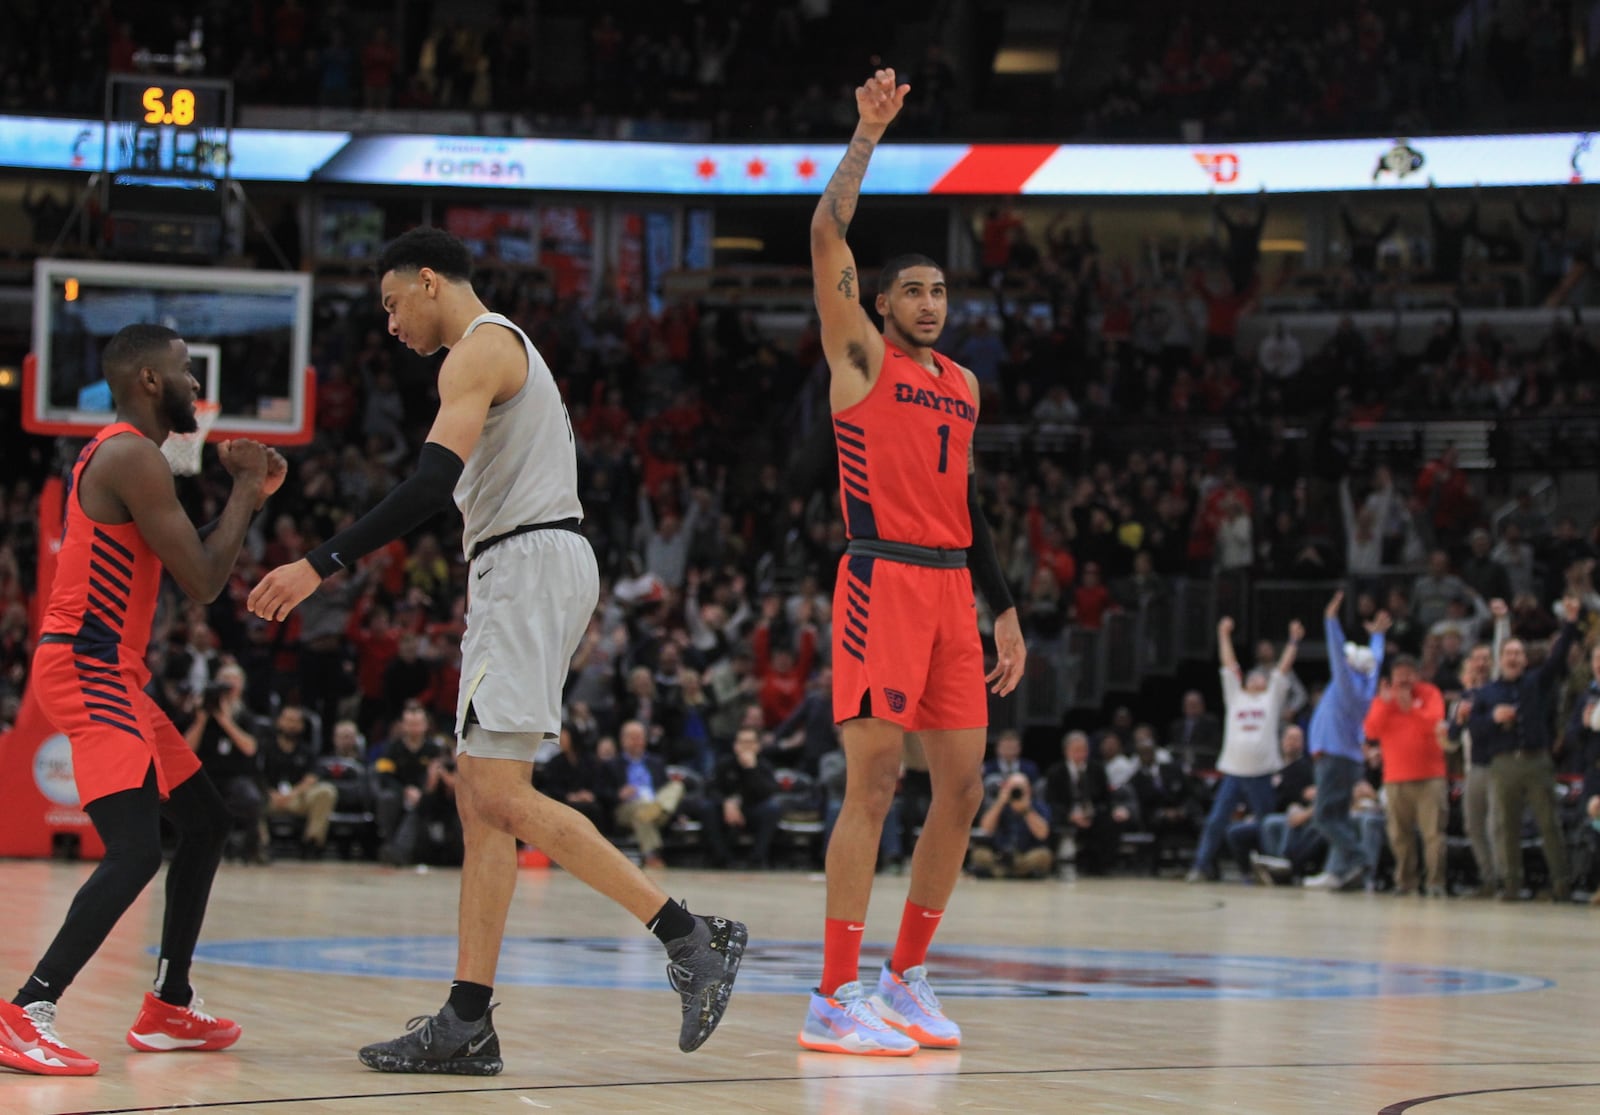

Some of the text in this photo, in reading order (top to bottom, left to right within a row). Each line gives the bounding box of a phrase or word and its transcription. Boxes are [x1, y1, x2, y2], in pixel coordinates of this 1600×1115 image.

[142, 86, 195, 126] 5.8
[424, 159, 525, 179] roman
[894, 382, 976, 424] DAYTON
[937, 423, 951, 474] 1
